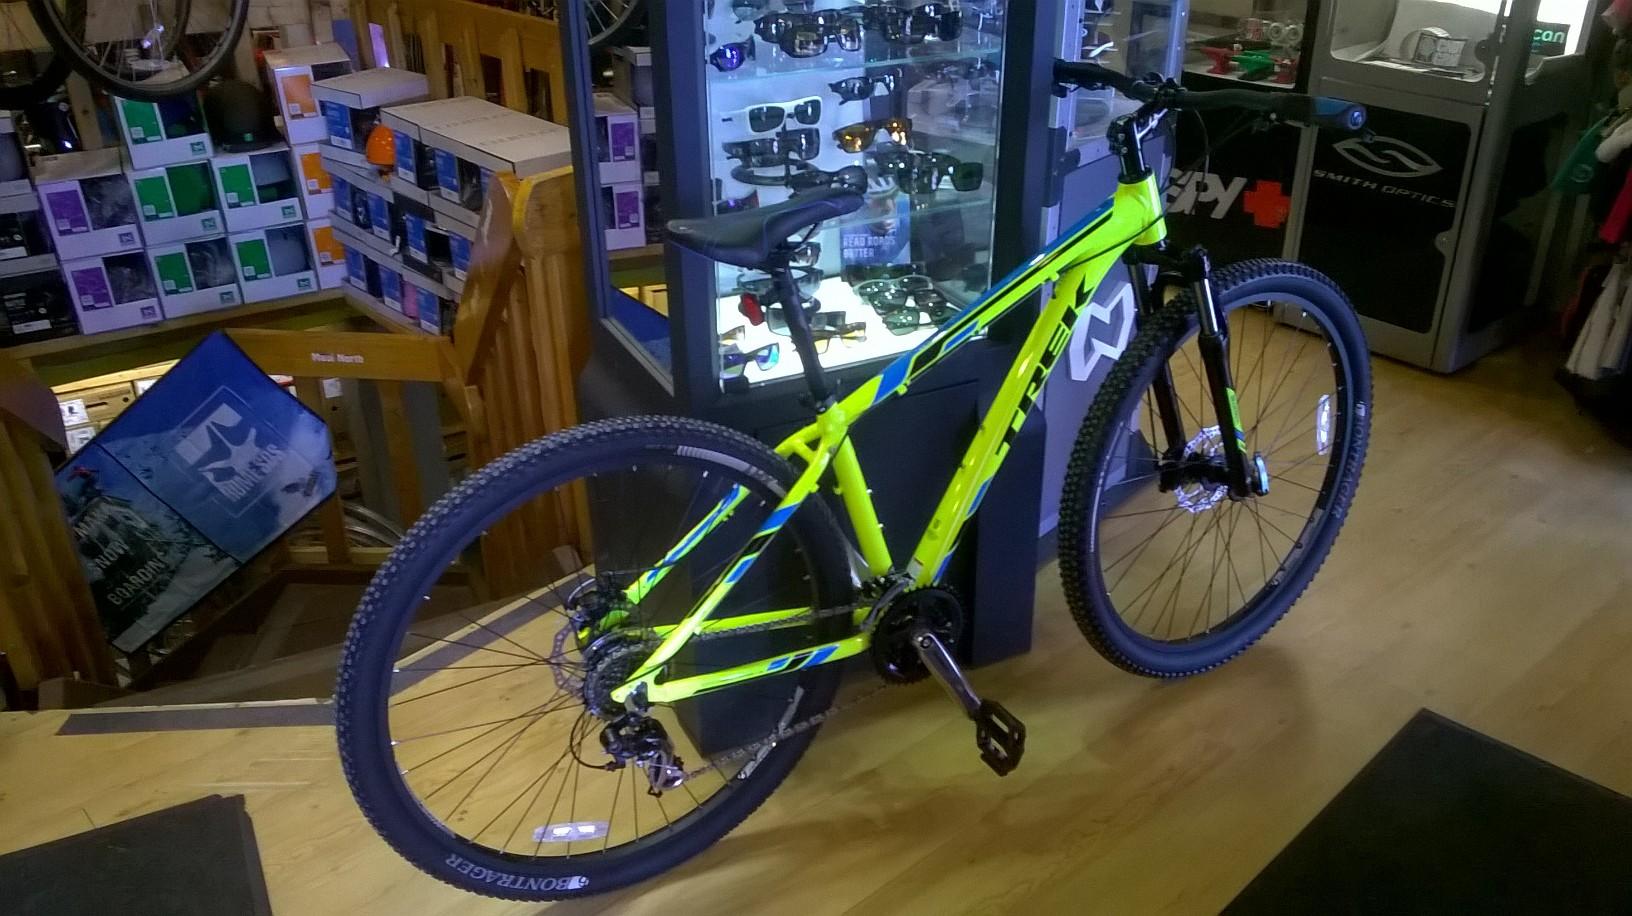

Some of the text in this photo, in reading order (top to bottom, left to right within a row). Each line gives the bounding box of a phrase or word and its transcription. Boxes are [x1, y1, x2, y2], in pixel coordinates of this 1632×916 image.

[1165, 168, 1248, 220] SPY
[1312, 168, 1457, 208] SMITH OPTICS
[842, 234, 866, 248] READ
[995, 274, 1095, 456] TREK
[94, 538, 129, 569] NOW
[444, 852, 570, 892] BONTRAGER
